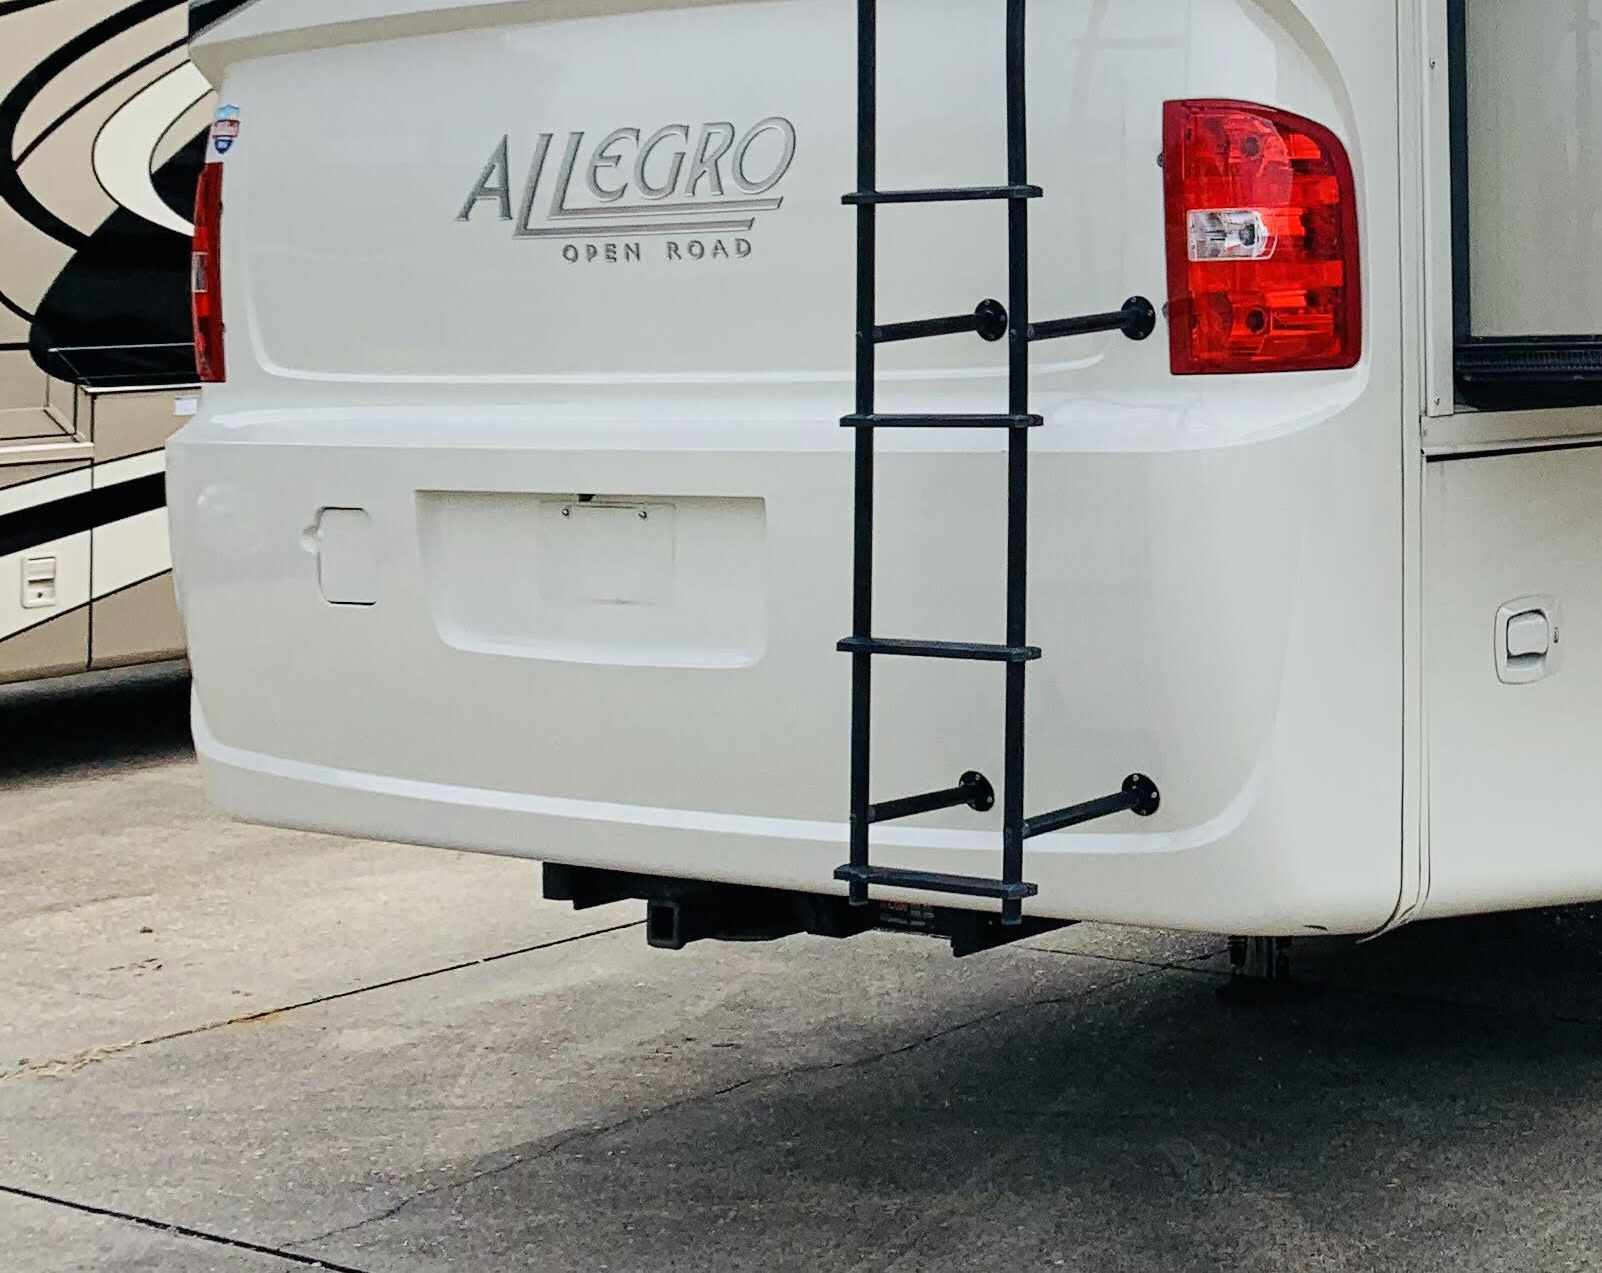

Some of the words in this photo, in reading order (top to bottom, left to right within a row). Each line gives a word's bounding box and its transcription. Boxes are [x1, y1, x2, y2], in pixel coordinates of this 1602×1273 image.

[455, 116, 797, 240] ALLEGRO
[562, 241, 642, 264] OPEN
[665, 238, 752, 261] ROAD
